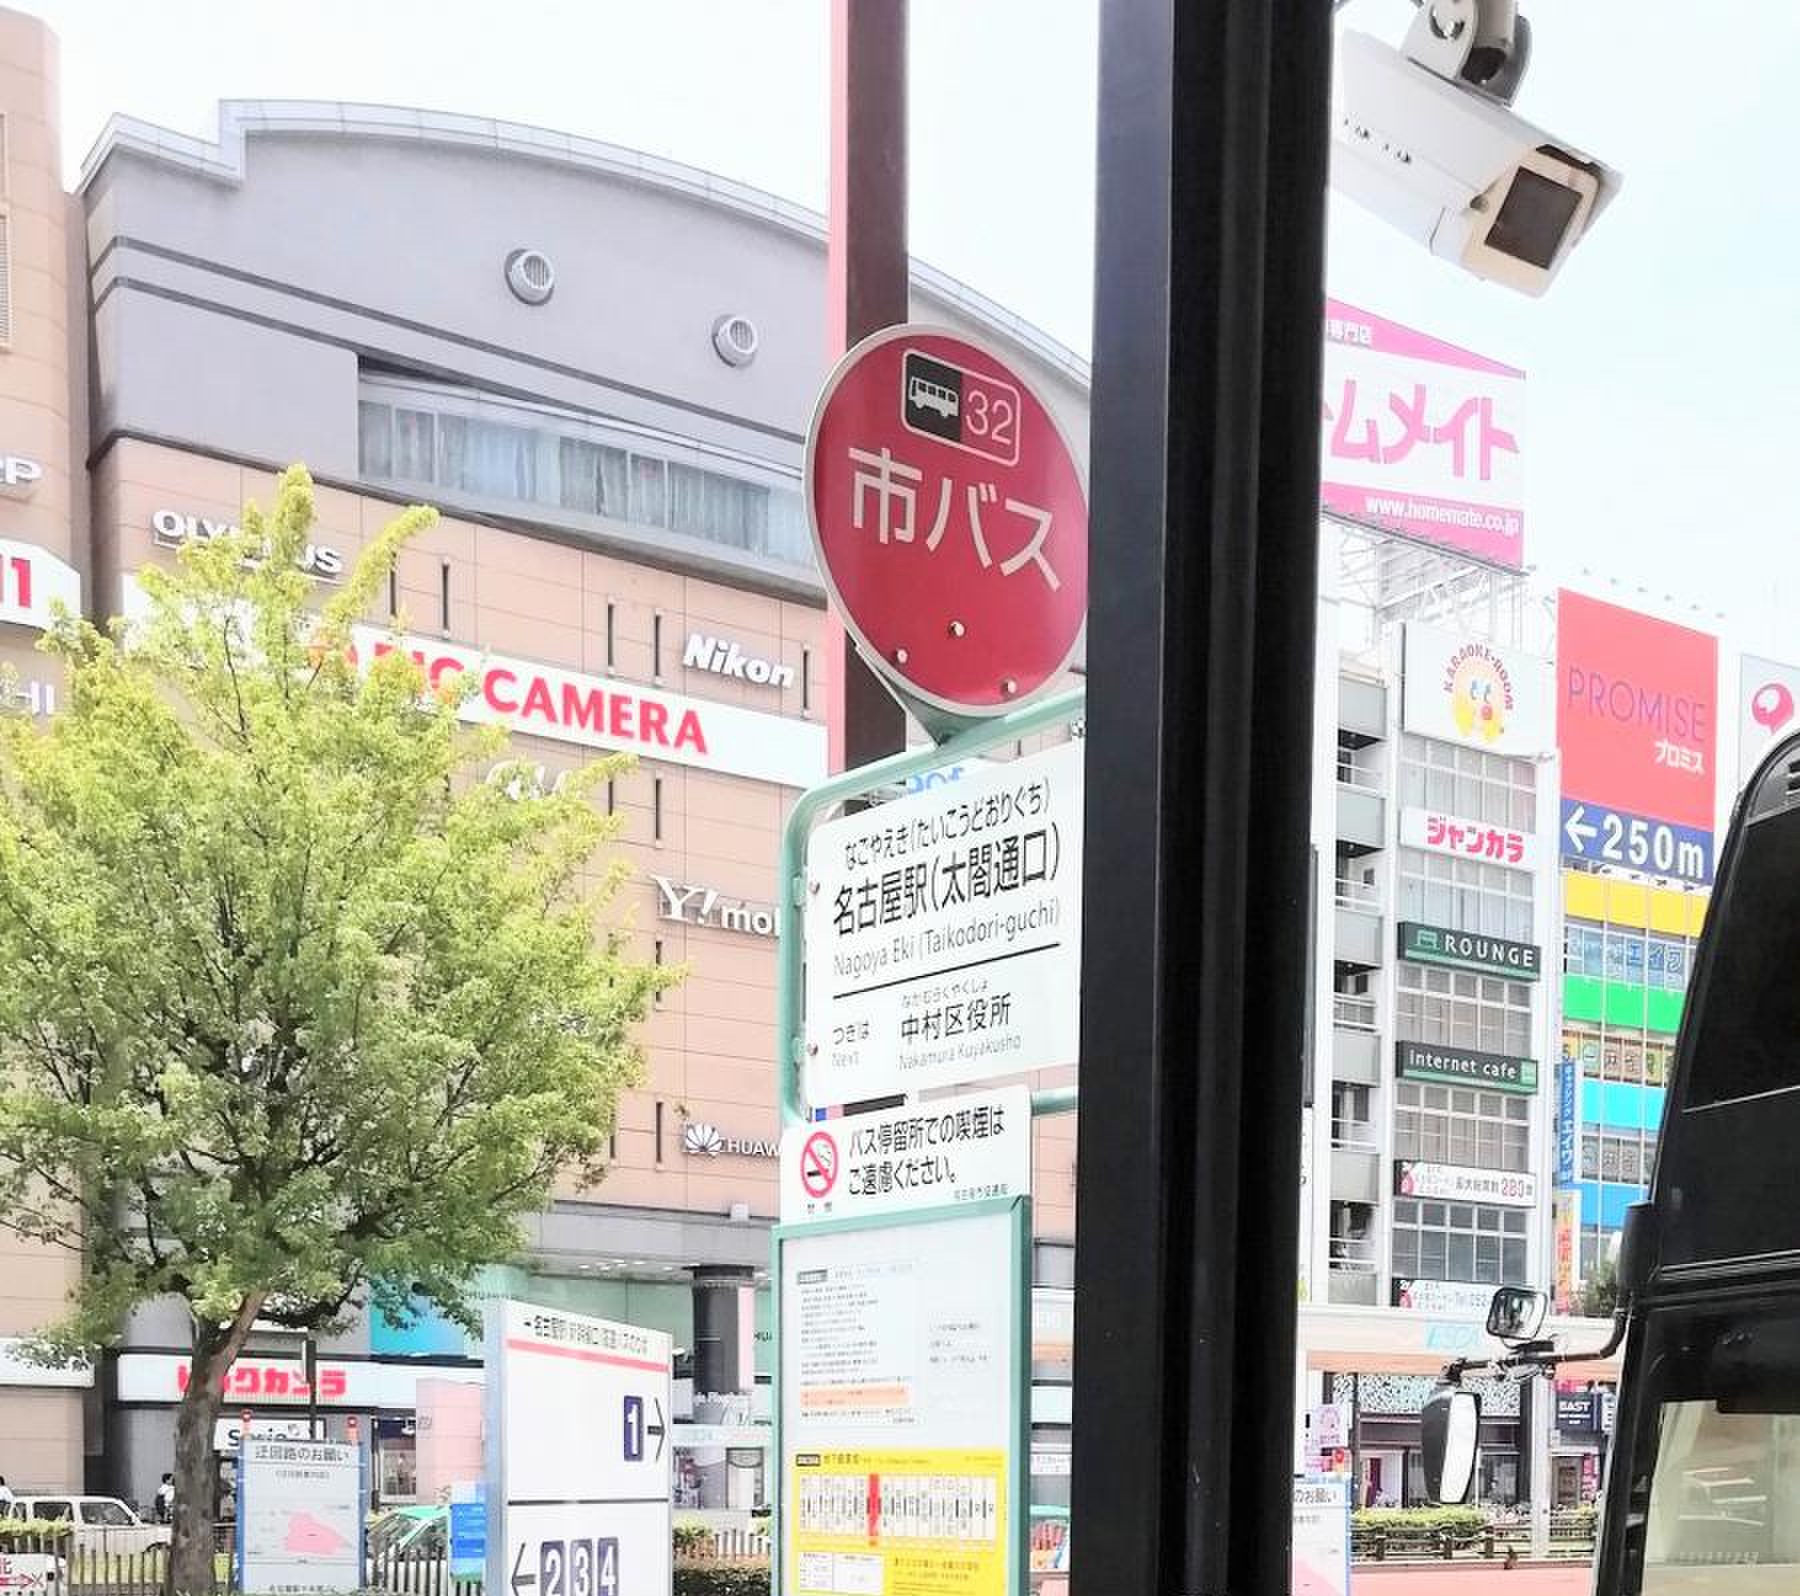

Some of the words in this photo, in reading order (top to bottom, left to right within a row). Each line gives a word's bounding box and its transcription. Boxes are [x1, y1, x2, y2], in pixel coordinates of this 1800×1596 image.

[966, 389, 1014, 446] 32
[1325, 379, 1520, 481] ムメイト
[848, 447, 1063, 593] 市バス
[1365, 497, 1520, 539] www.homemate.co.jp
[682, 633, 795, 690] Nikon
[482, 668, 708, 755] CAMERA
[1568, 667, 1706, 743] PROMISE
[1654, 738, 1706, 775] プロミス
[1427, 815, 1526, 863] ジャンカラ
[1602, 813, 1704, 879] 250m
[832, 943, 889, 978] Nagoya
[892, 934, 917, 965] Eki
[1445, 933, 1534, 967] ROUNGE
[900, 992, 1012, 1045] 中村区役所
[849, 1105, 1005, 1158] バス停留所での喫煙は
[849, 1155, 956, 1196] ご遠慮ください。
